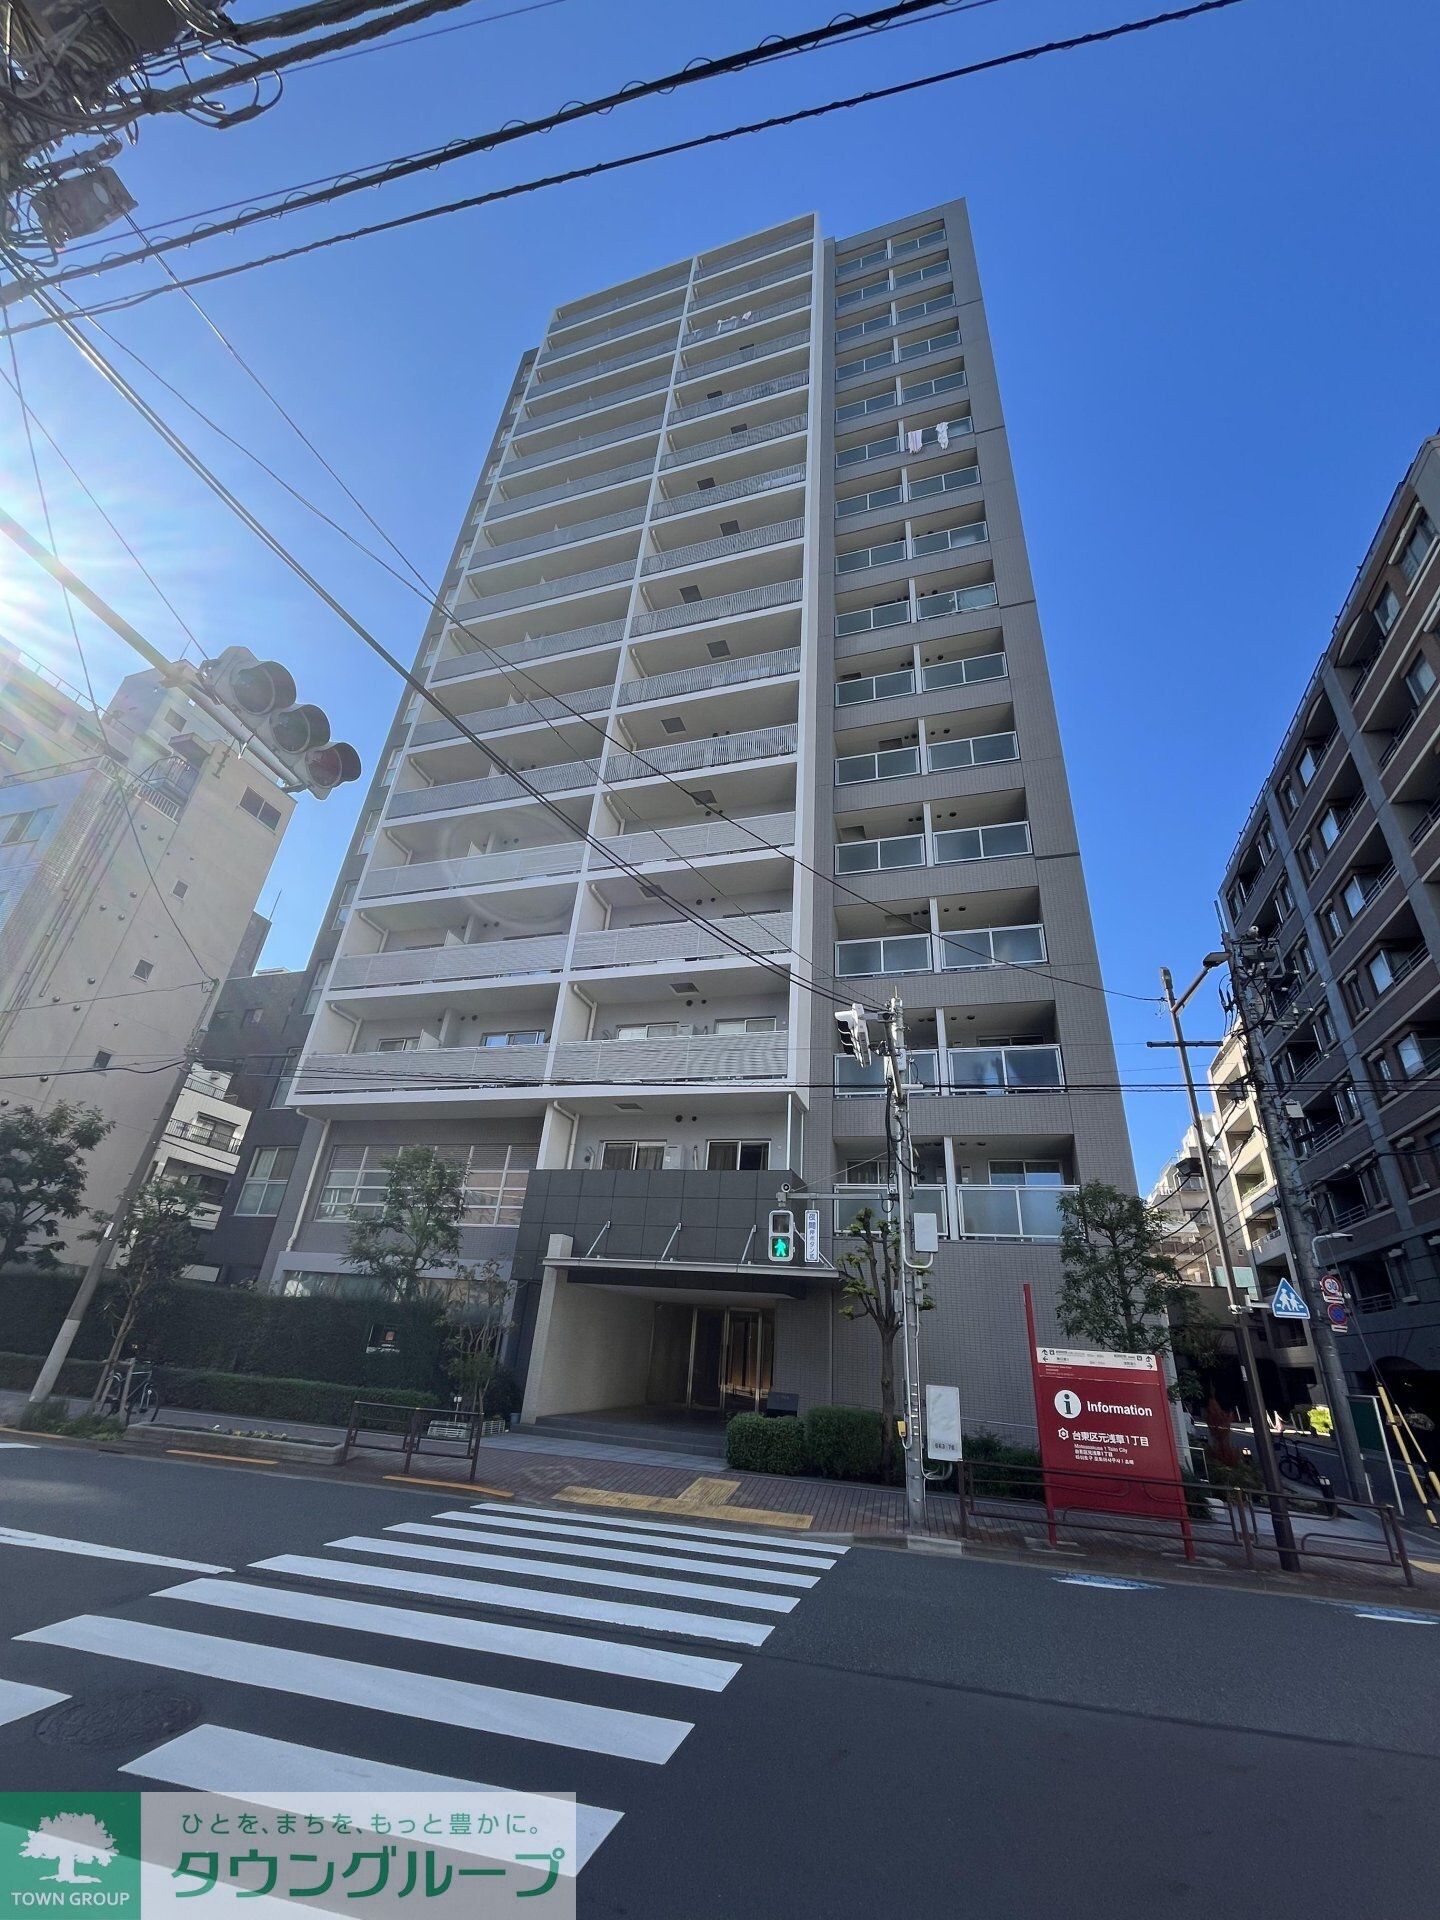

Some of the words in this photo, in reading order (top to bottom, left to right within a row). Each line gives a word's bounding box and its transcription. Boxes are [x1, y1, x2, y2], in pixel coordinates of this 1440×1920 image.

[1086, 1400, 1153, 1417] Information
[1072, 1430, 1149, 1447] 台東区元浅草1丁目
